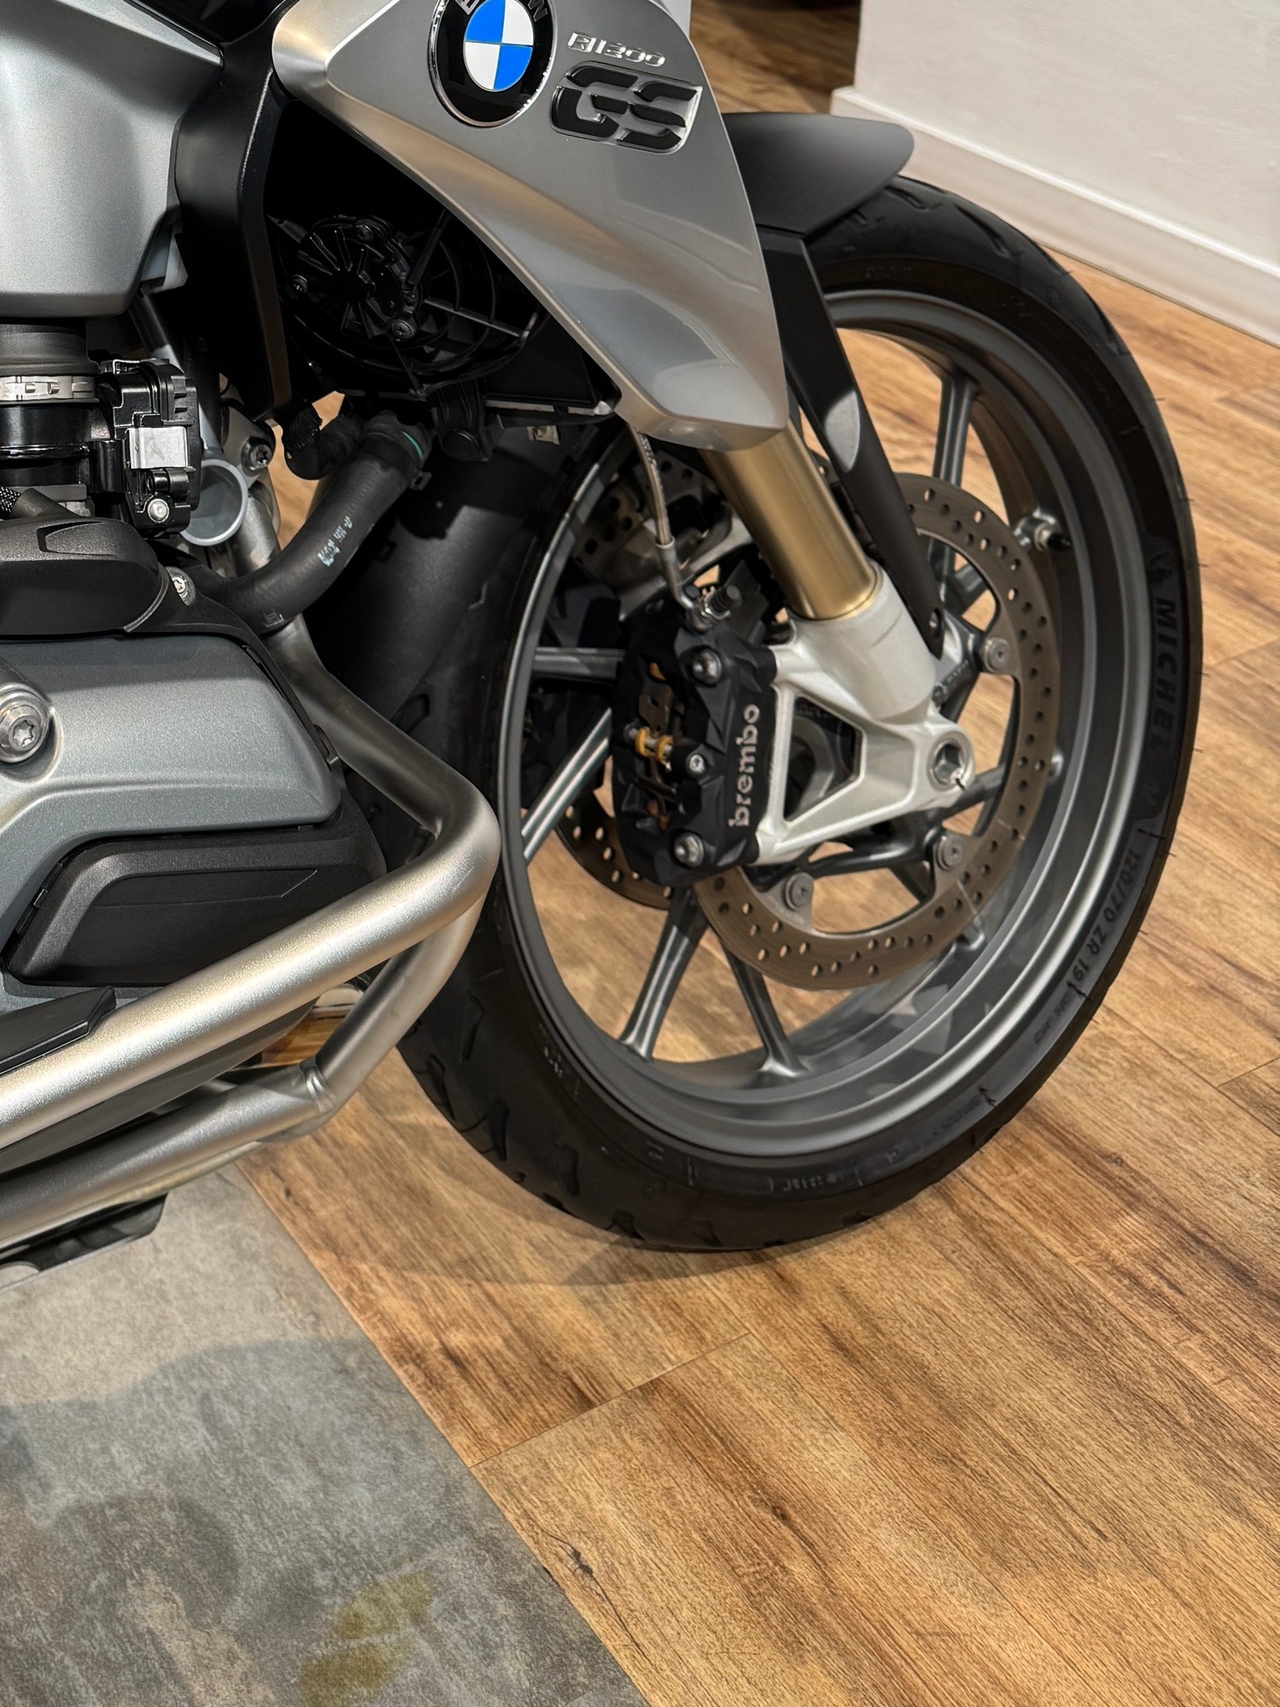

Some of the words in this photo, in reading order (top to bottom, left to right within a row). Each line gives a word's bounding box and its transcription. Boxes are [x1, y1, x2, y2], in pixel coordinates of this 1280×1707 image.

[549, 60, 704, 156] GS
[1142, 597, 1179, 807] MICHELN
[728, 703, 760, 828] brembo
[1103, 849, 1141, 922] 120/70
[1072, 956, 1090, 981] 19
[1086, 925, 1107, 956] ZR
